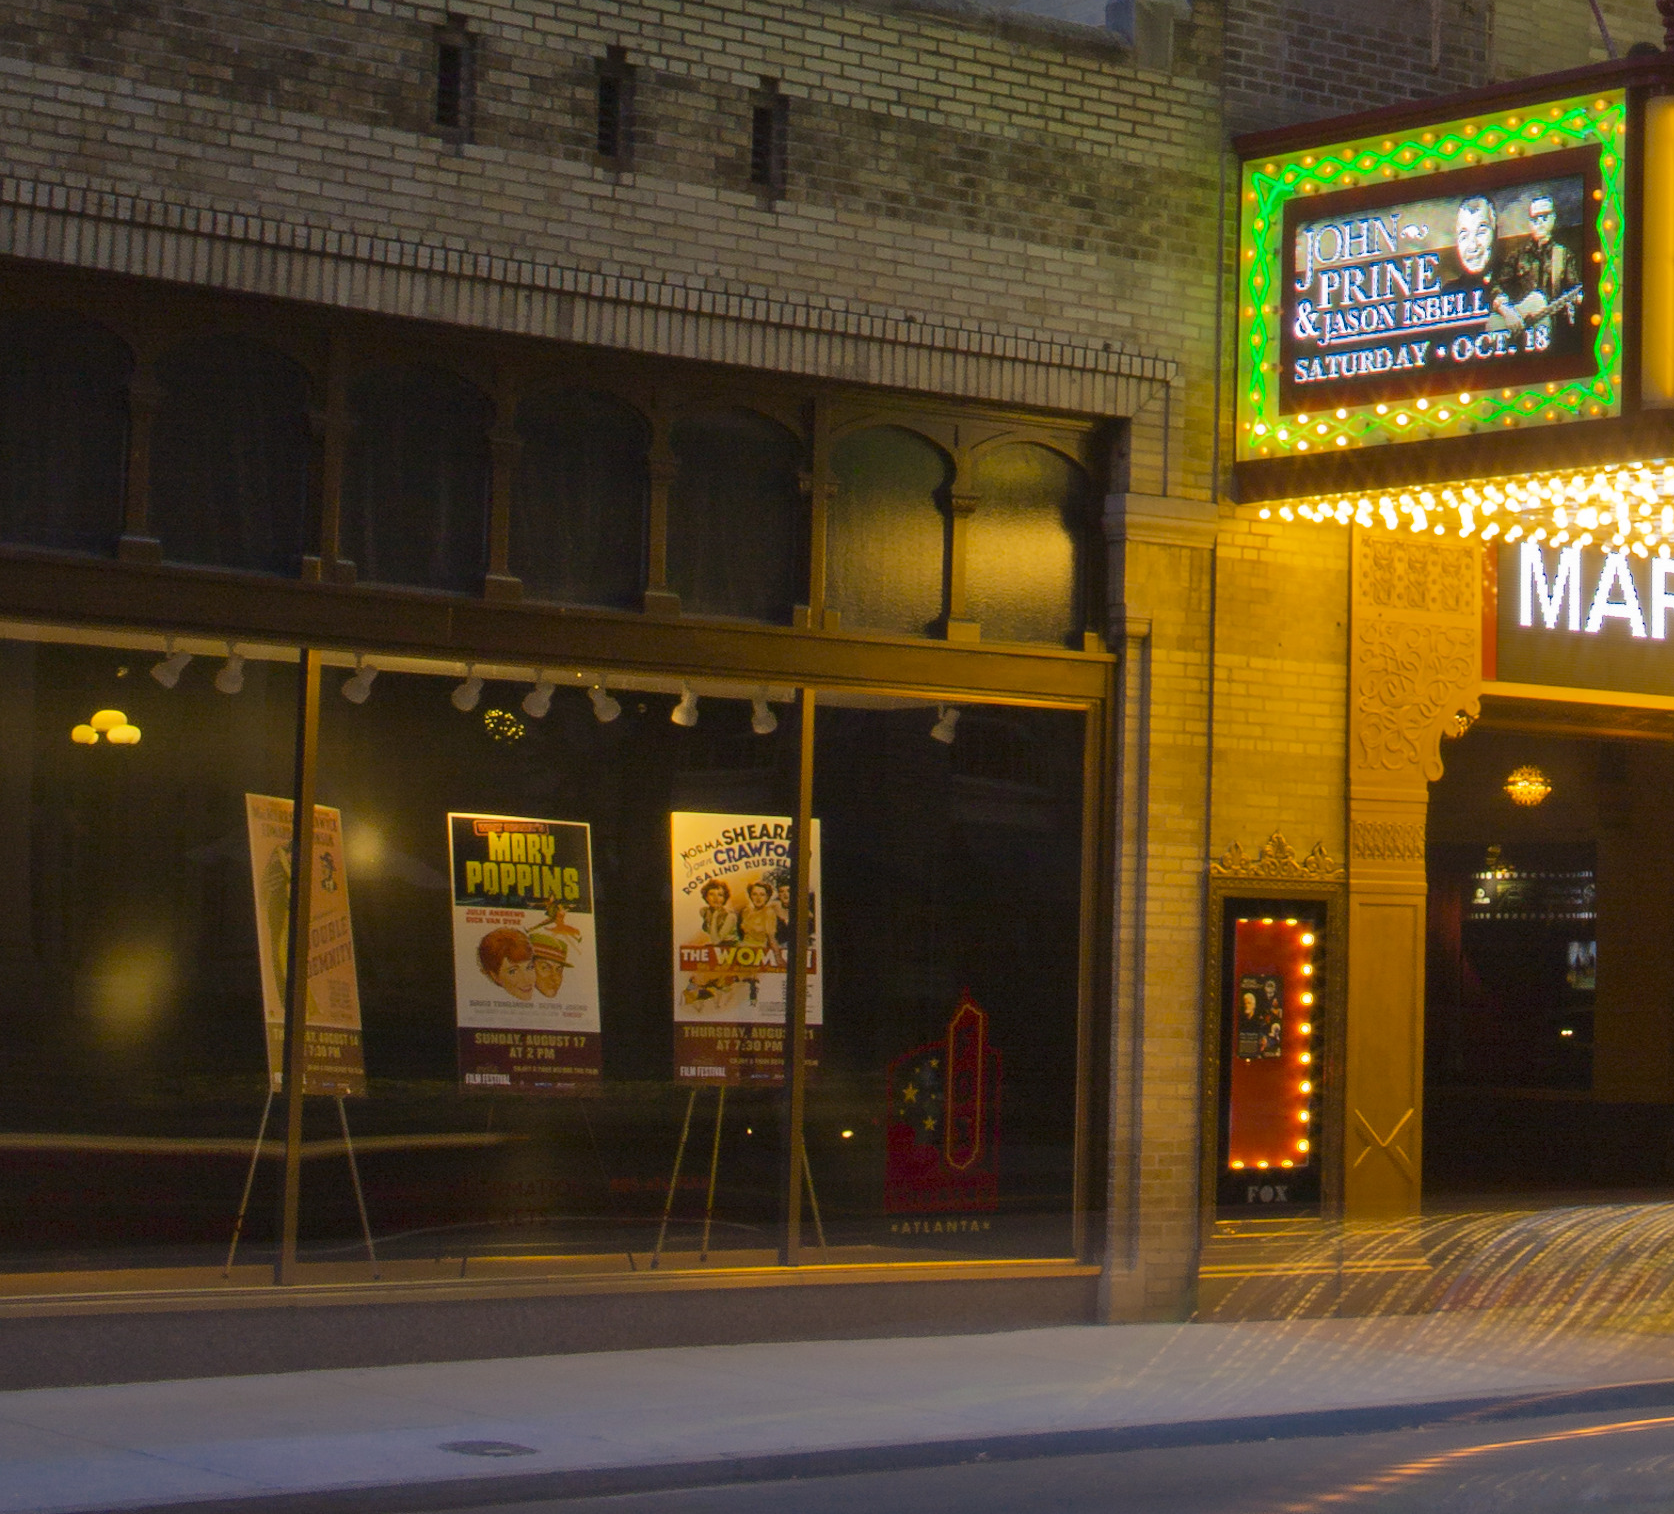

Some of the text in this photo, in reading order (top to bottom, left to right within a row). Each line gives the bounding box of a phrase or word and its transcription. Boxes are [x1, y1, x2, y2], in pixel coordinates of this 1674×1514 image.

[1295, 213, 1401, 291] JOHN
[1318, 253, 1441, 309] PRINE
[1318, 303, 1396, 346] JASON
[1403, 288, 1490, 325] ISBELL
[1295, 325, 1550, 384] SATURDAY OCT. 18
[488, 832, 555, 864] MARY
[680, 823, 792, 860] NORMA SHEARE
[714, 841, 791, 865] CRAWFO
[466, 860, 580, 900] POPPINS
[682, 859, 790, 895] ROSALIND RUSSEL
[311, 916, 349, 948] OUBLE
[681, 948, 709, 962] THE
[526, 1034, 570, 1047] AUGUST
[573, 1036, 586, 1048] 17
[716, 1039, 783, 1052] AT 7:30 PM
[751, 1028, 785, 1040] AUGU
[509, 1047, 555, 1059] AT 2 PM
[465, 1073, 511, 1086] FILM FESTIVAL
[680, 1066, 726, 1078] FILM FESTIVAL
[1248, 1185, 1288, 1202] FOX
[901, 1220, 980, 1234] ATLANTA
